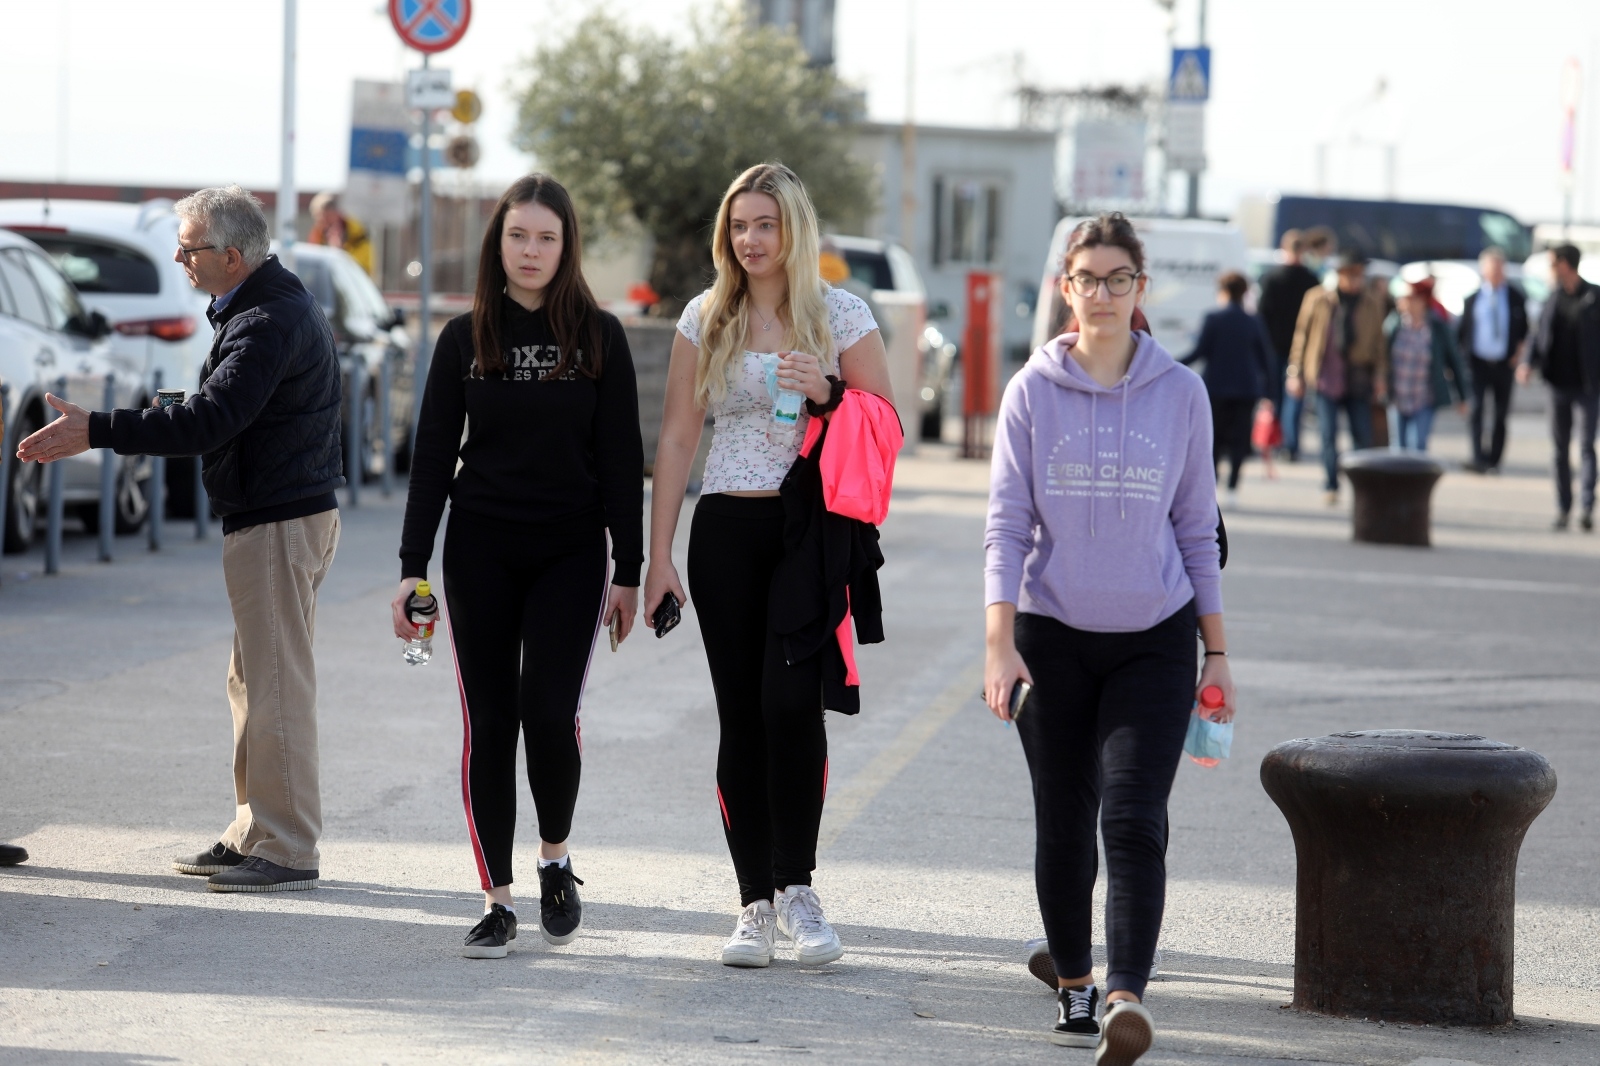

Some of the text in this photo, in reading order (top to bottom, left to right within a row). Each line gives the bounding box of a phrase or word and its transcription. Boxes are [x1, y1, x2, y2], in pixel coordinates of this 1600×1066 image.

[1046, 463, 1166, 485] EVERY CHANCE
[1115, 491, 1144, 499] HPPEN
